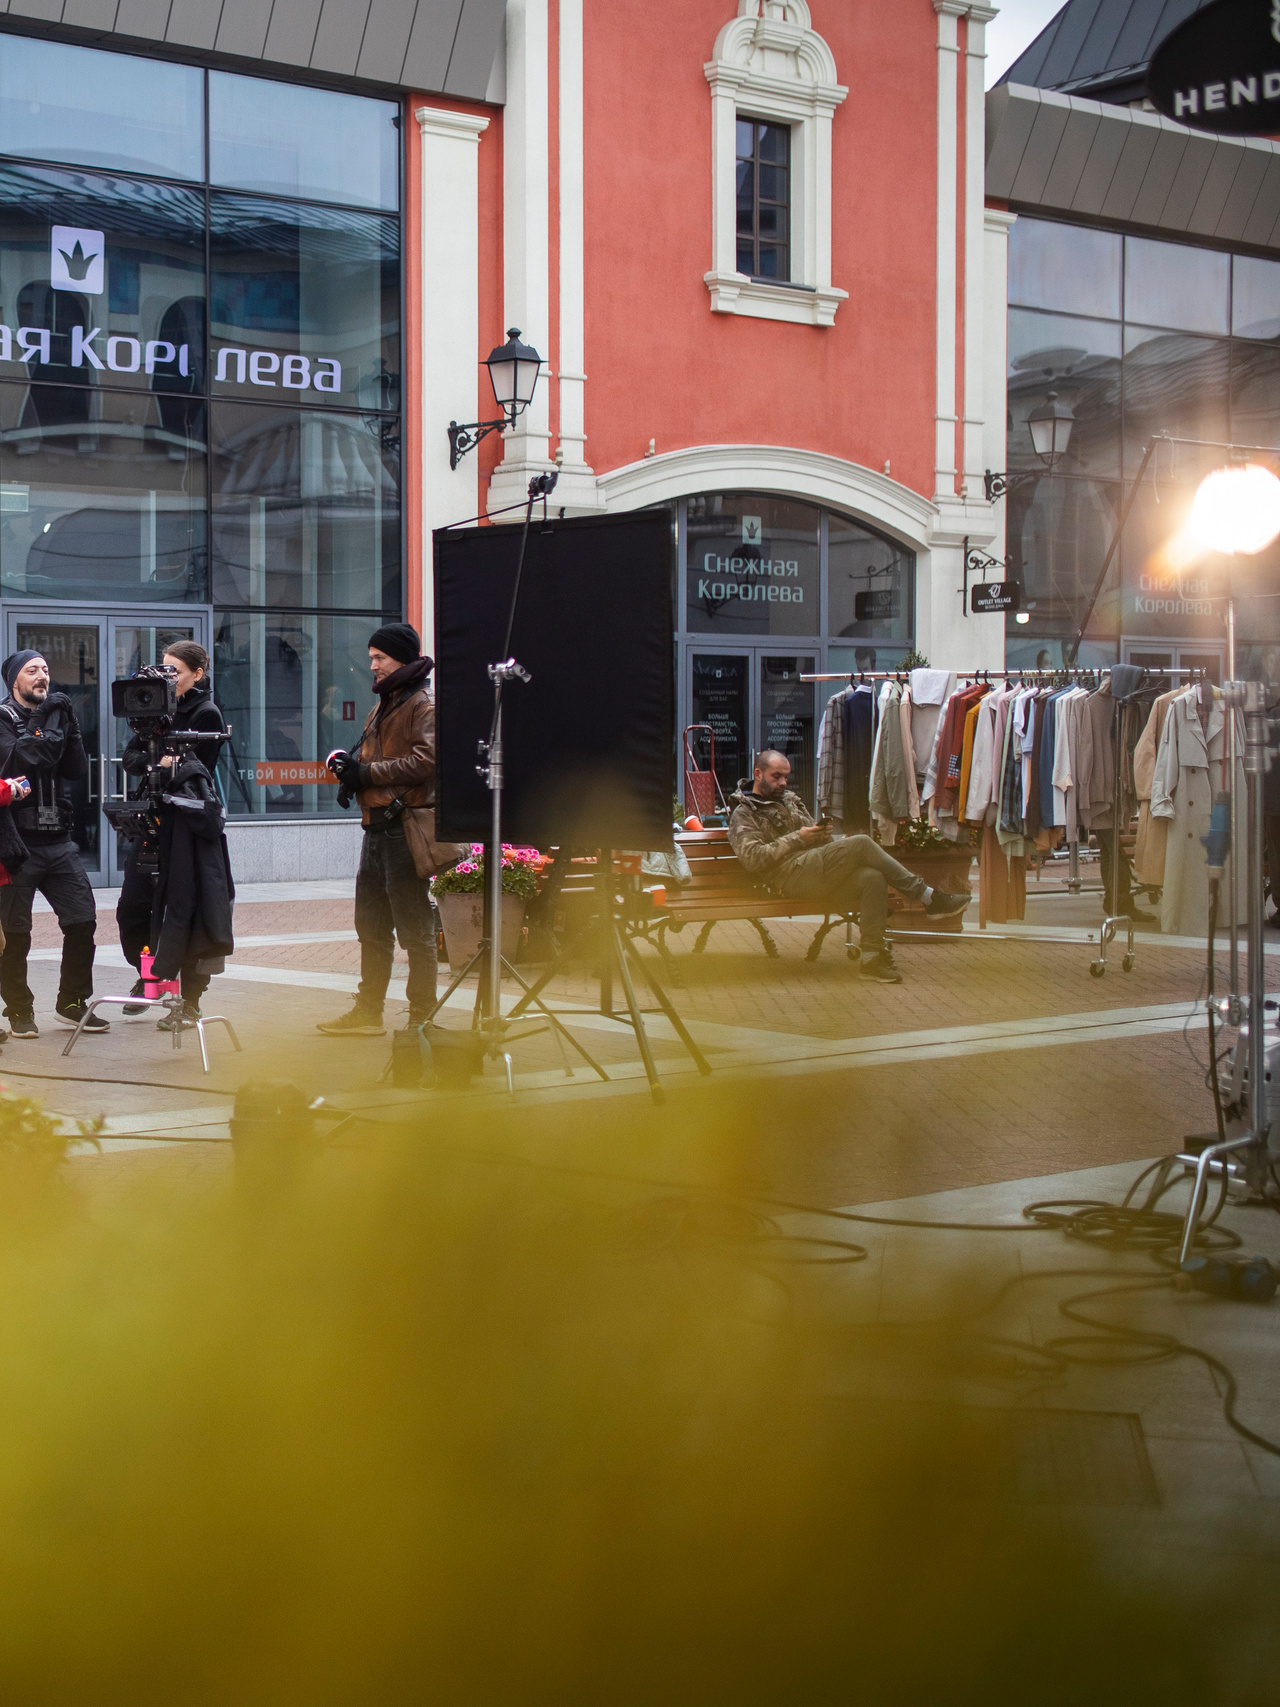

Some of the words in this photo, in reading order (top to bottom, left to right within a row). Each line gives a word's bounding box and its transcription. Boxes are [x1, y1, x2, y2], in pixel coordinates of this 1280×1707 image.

[1175, 73, 1280, 116] HEND
[71, 325, 342, 393] Корлева
[704, 553, 798, 577] Снежная
[698, 579, 804, 603] Королева
[1140, 574, 1209, 593] Снежная
[1135, 596, 1212, 615] Королева
[238, 767, 274, 780] ТВОЙ
[280, 766, 327, 779] НОВЫЙ
